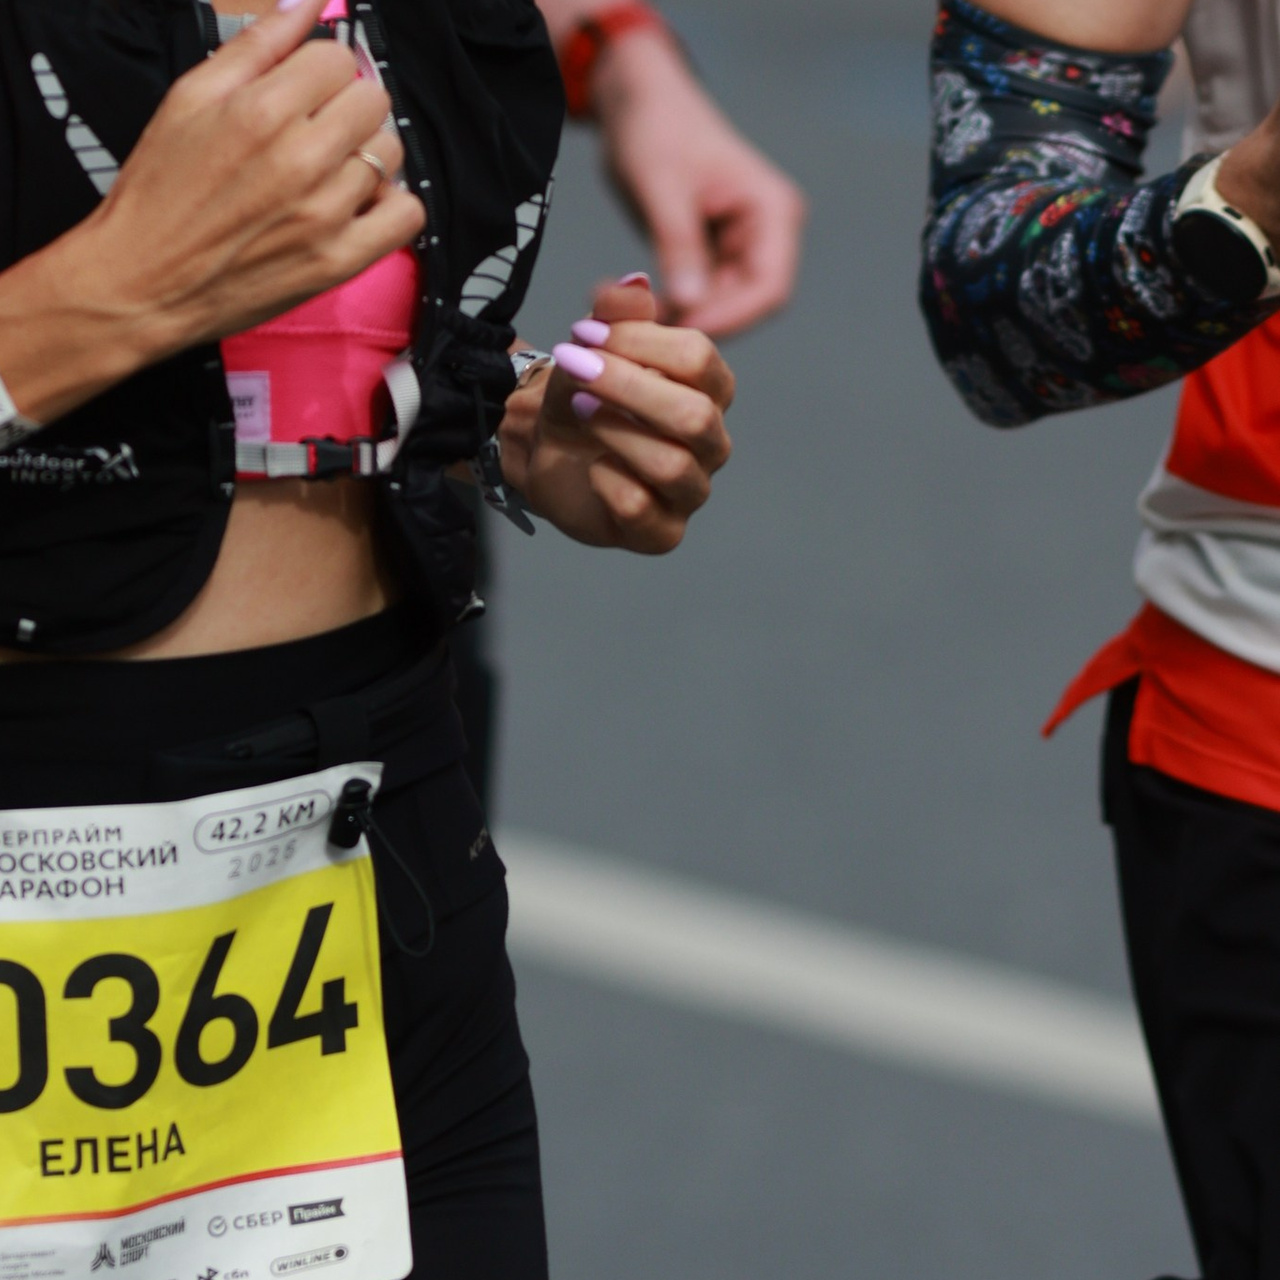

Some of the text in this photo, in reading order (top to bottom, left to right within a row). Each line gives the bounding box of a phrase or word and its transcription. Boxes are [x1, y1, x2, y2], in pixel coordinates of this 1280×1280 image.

[210, 799, 316, 841] 42,2 КМ
[39, 1122, 186, 1177] ЕЛЕНА
[121, 1217, 186, 1249] МОСКОВСКИЙ
[232, 1204, 337, 1231] СБЕР Прайм
[276, 1251, 332, 1272] WINLINE
